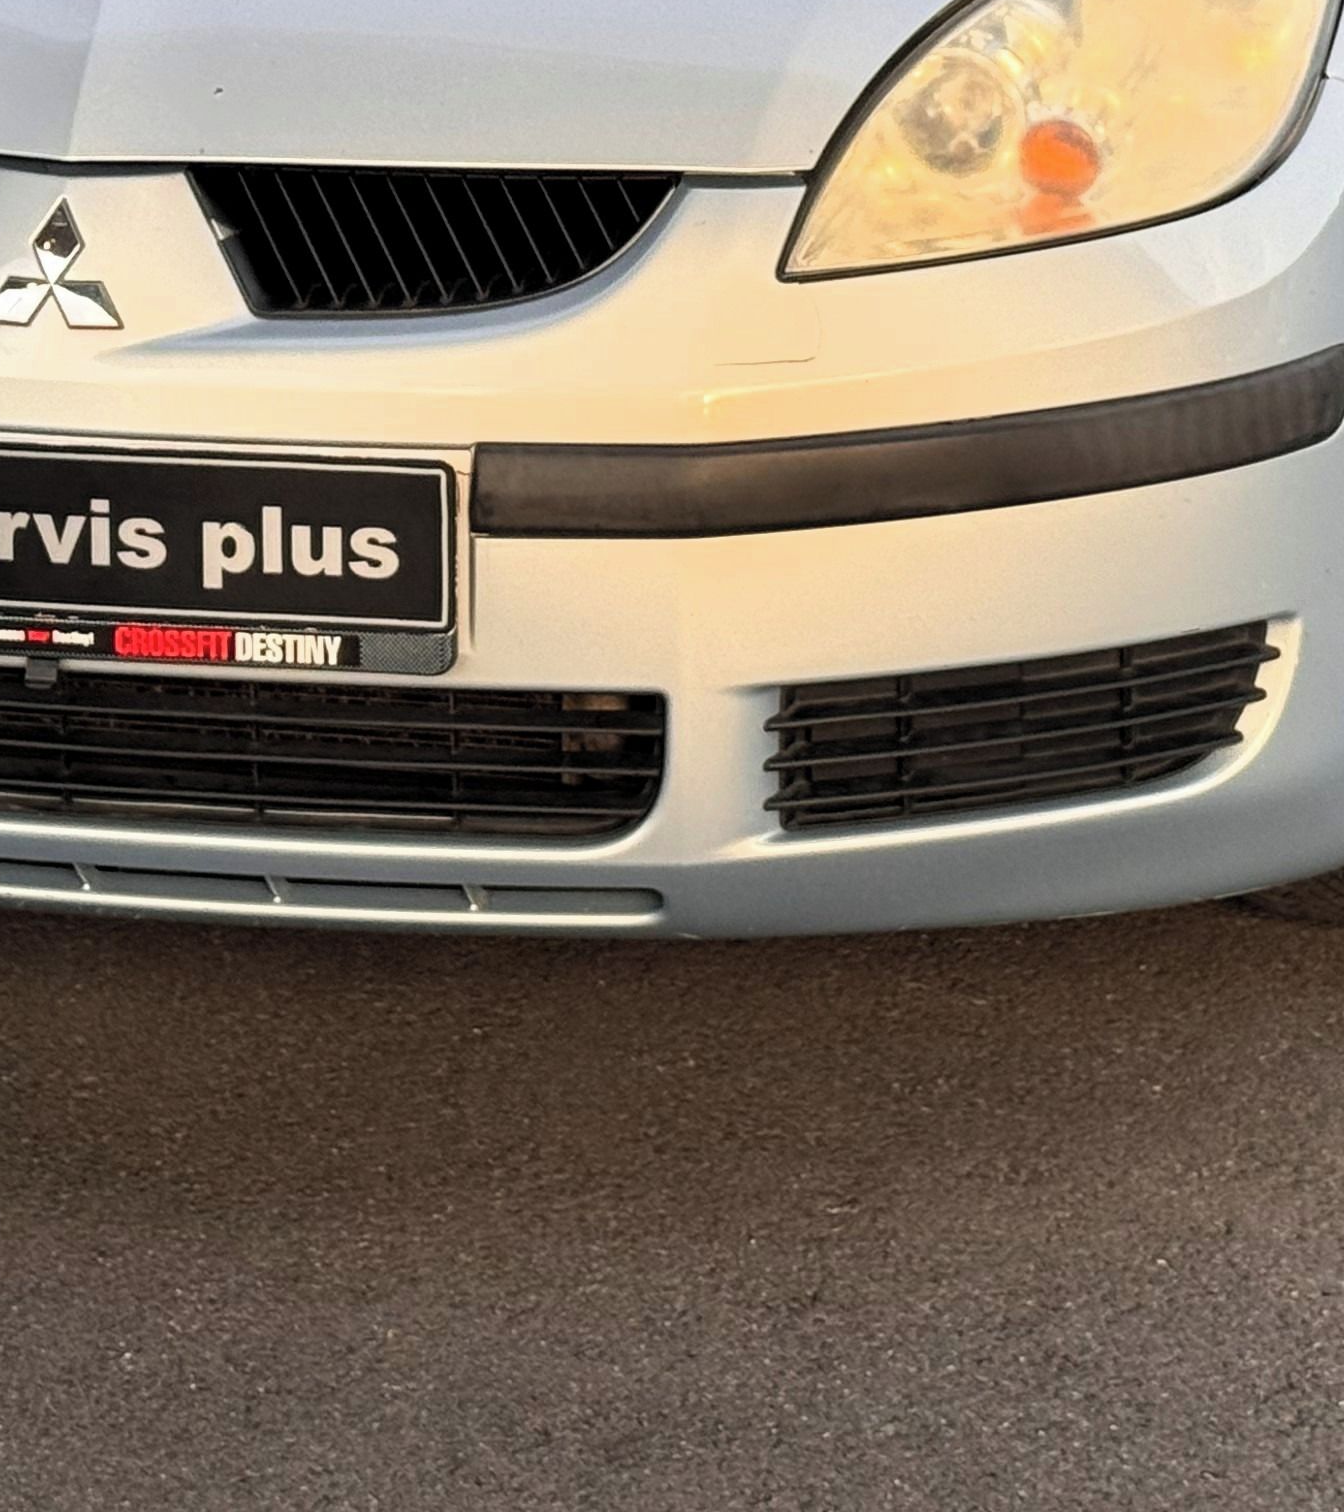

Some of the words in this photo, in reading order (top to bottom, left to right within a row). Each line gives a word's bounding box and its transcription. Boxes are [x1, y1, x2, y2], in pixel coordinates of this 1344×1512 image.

[202, 506, 399, 589] plus
[114, 626, 232, 660] CROSSFIT
[234, 631, 342, 666] DESTINY
